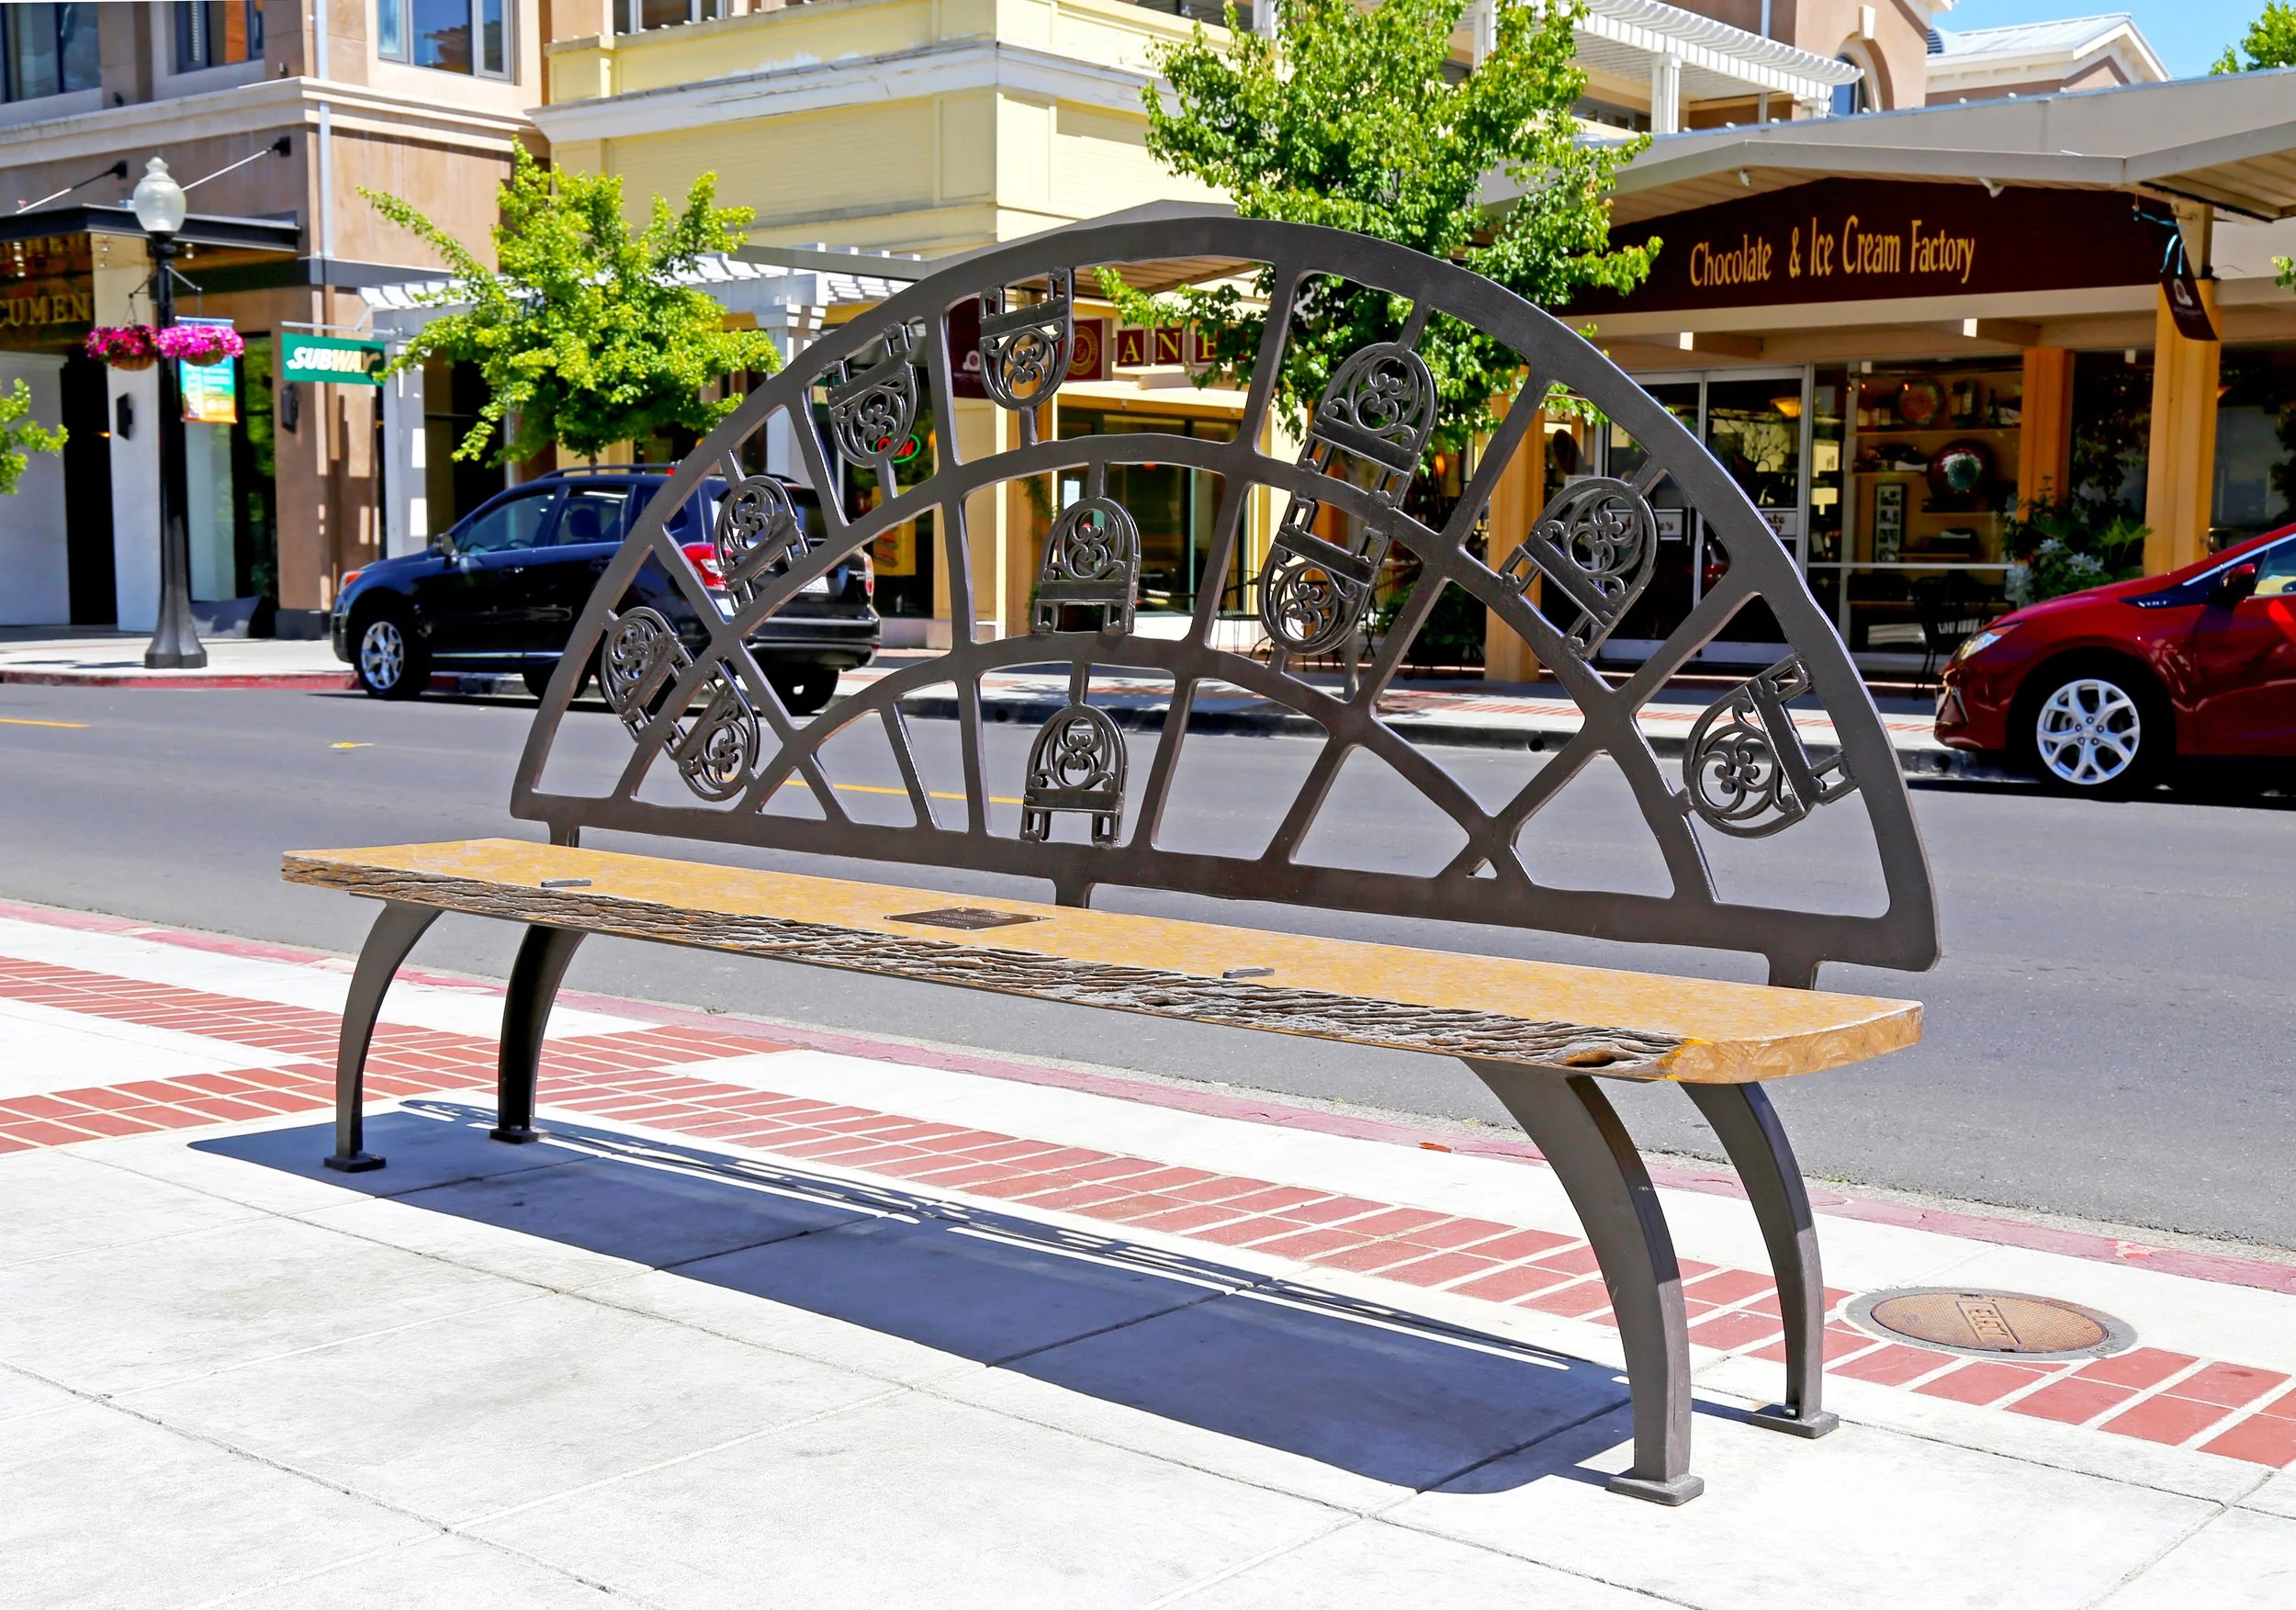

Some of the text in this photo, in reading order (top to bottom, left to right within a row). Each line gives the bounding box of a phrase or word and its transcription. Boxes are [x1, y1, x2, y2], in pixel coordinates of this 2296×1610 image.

[1690, 214, 1975, 287] Chocolate & Ice Cream Factory
[286, 346, 382, 374] SUBWAY
[1967, 1308, 2009, 1338] ELECT
